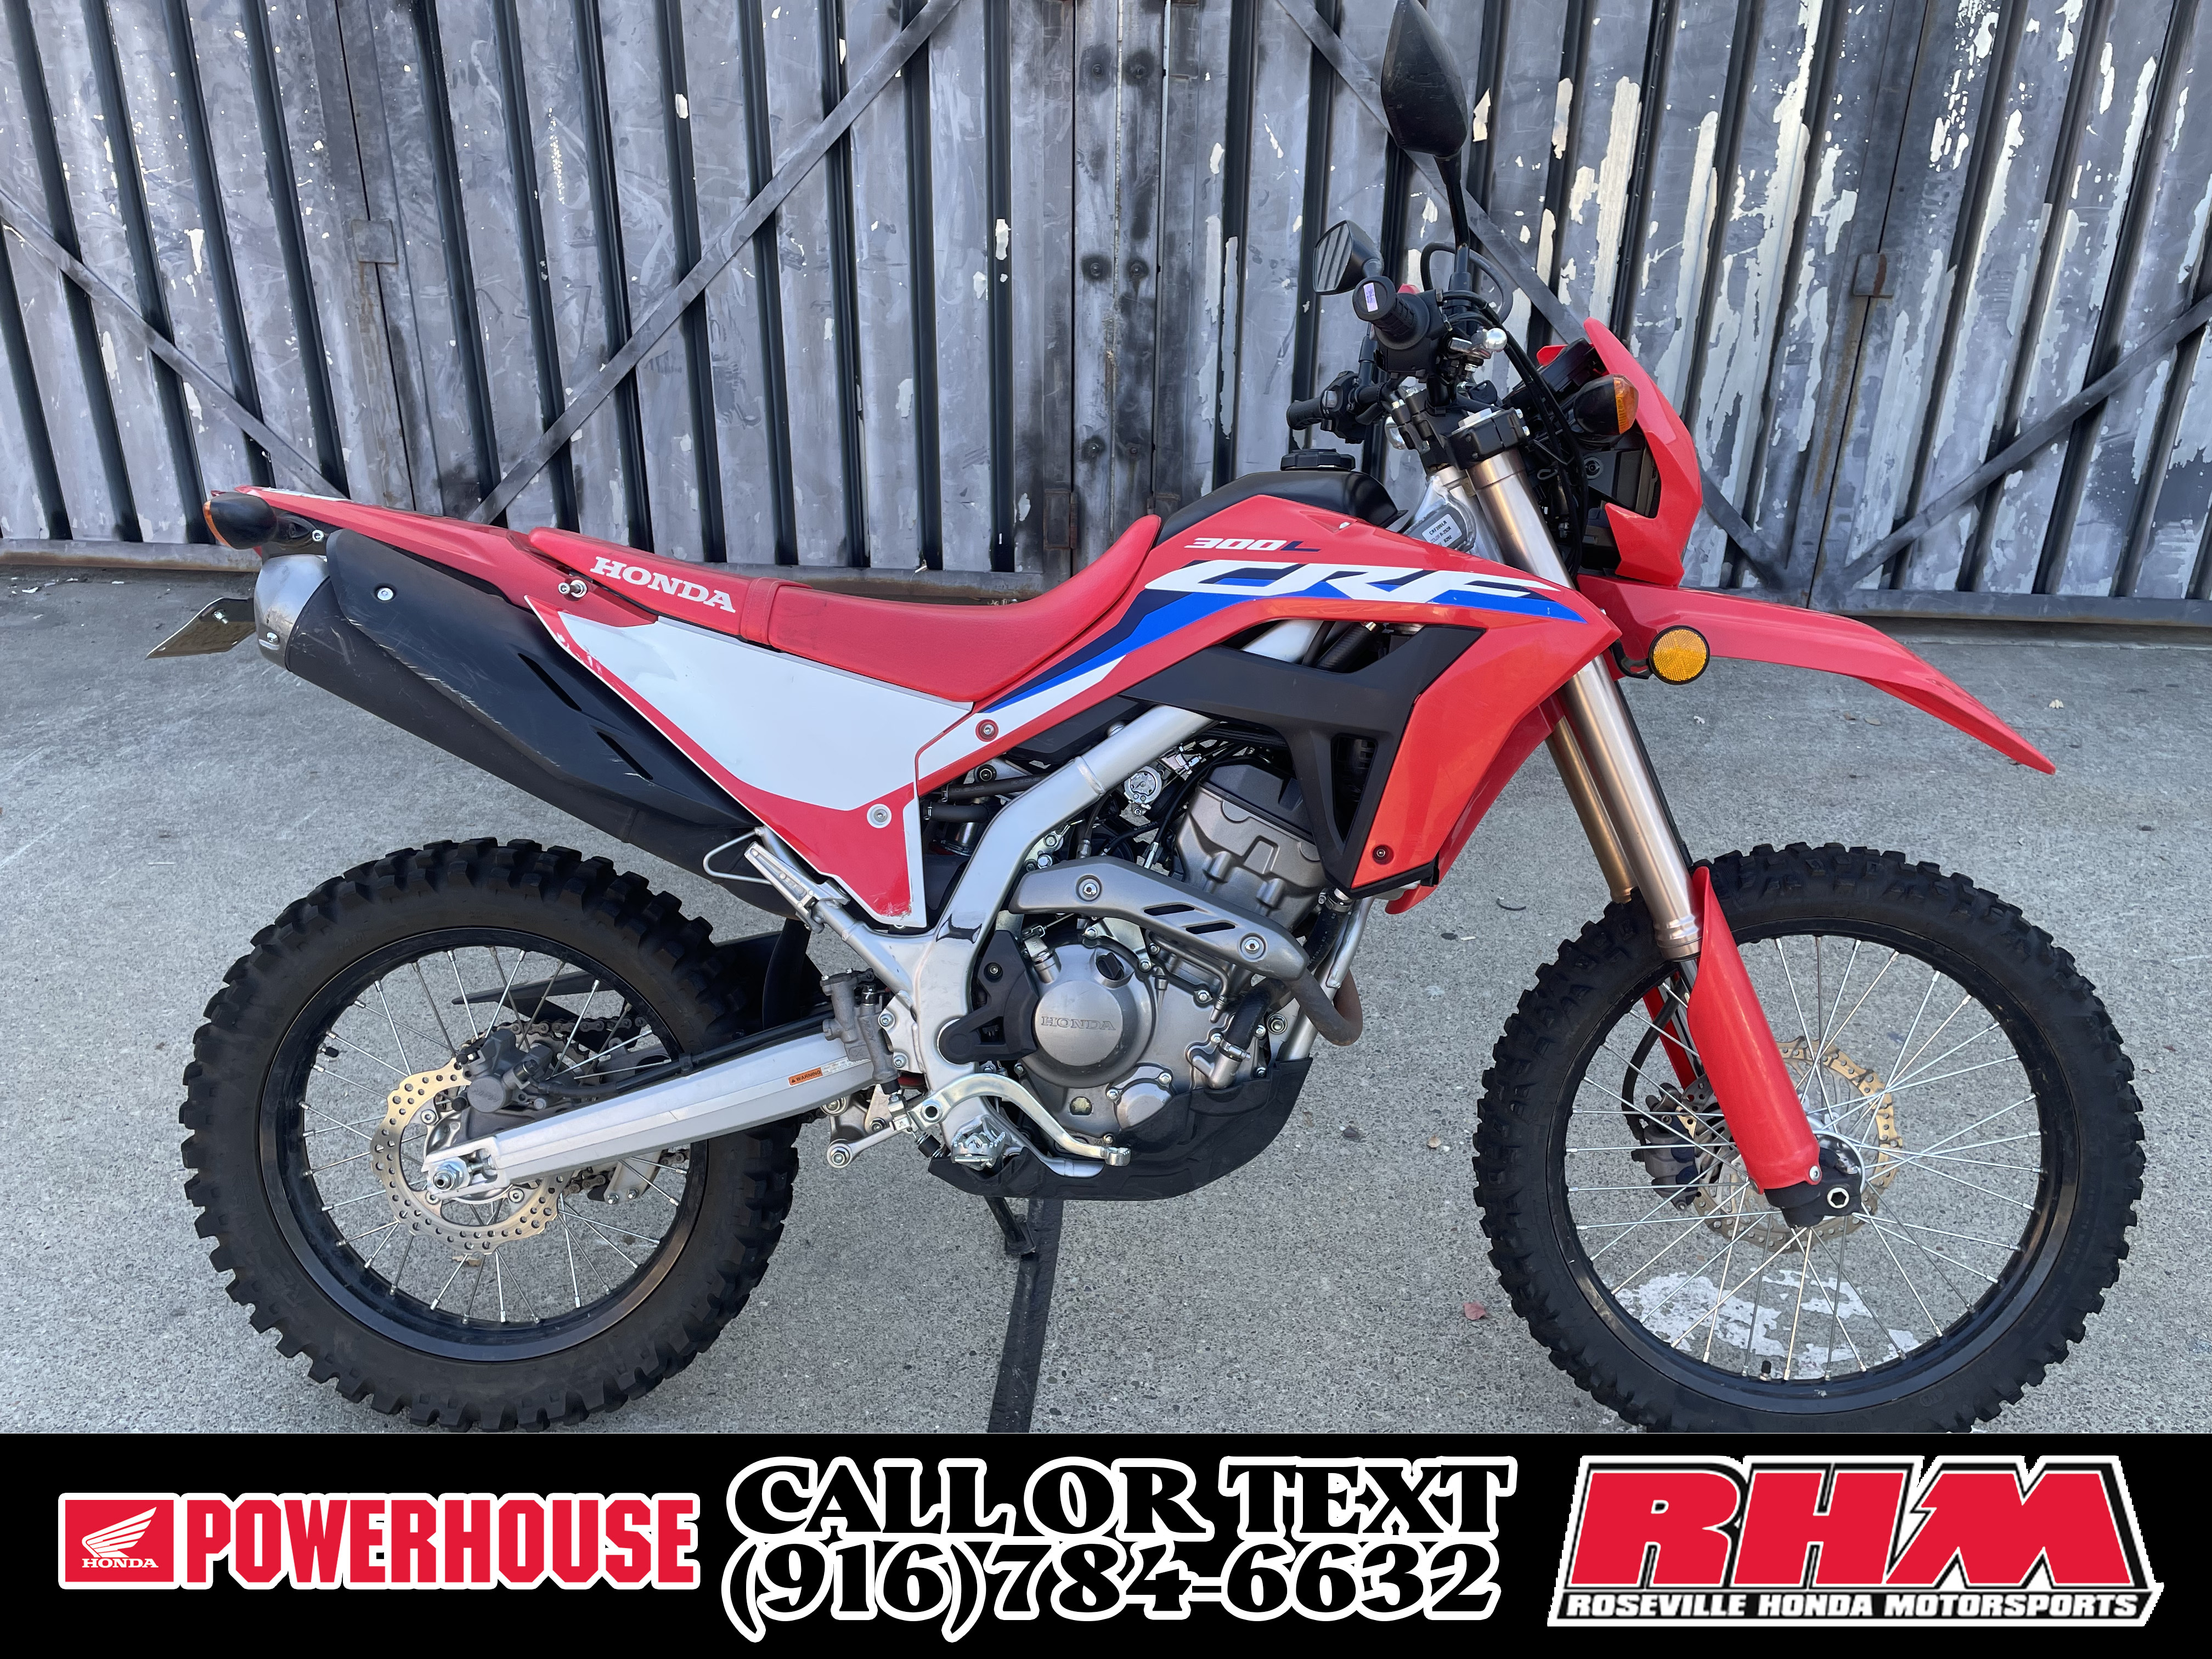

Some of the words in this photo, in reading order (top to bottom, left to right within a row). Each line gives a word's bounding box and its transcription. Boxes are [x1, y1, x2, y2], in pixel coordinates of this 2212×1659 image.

[1184, 537, 1322, 552] 300L
[590, 556, 736, 613] HONDA
[1144, 560, 1561, 604] CRF
[1041, 1015, 1116, 1030] HONDA
[796, 1070, 822, 1081] WARNING
